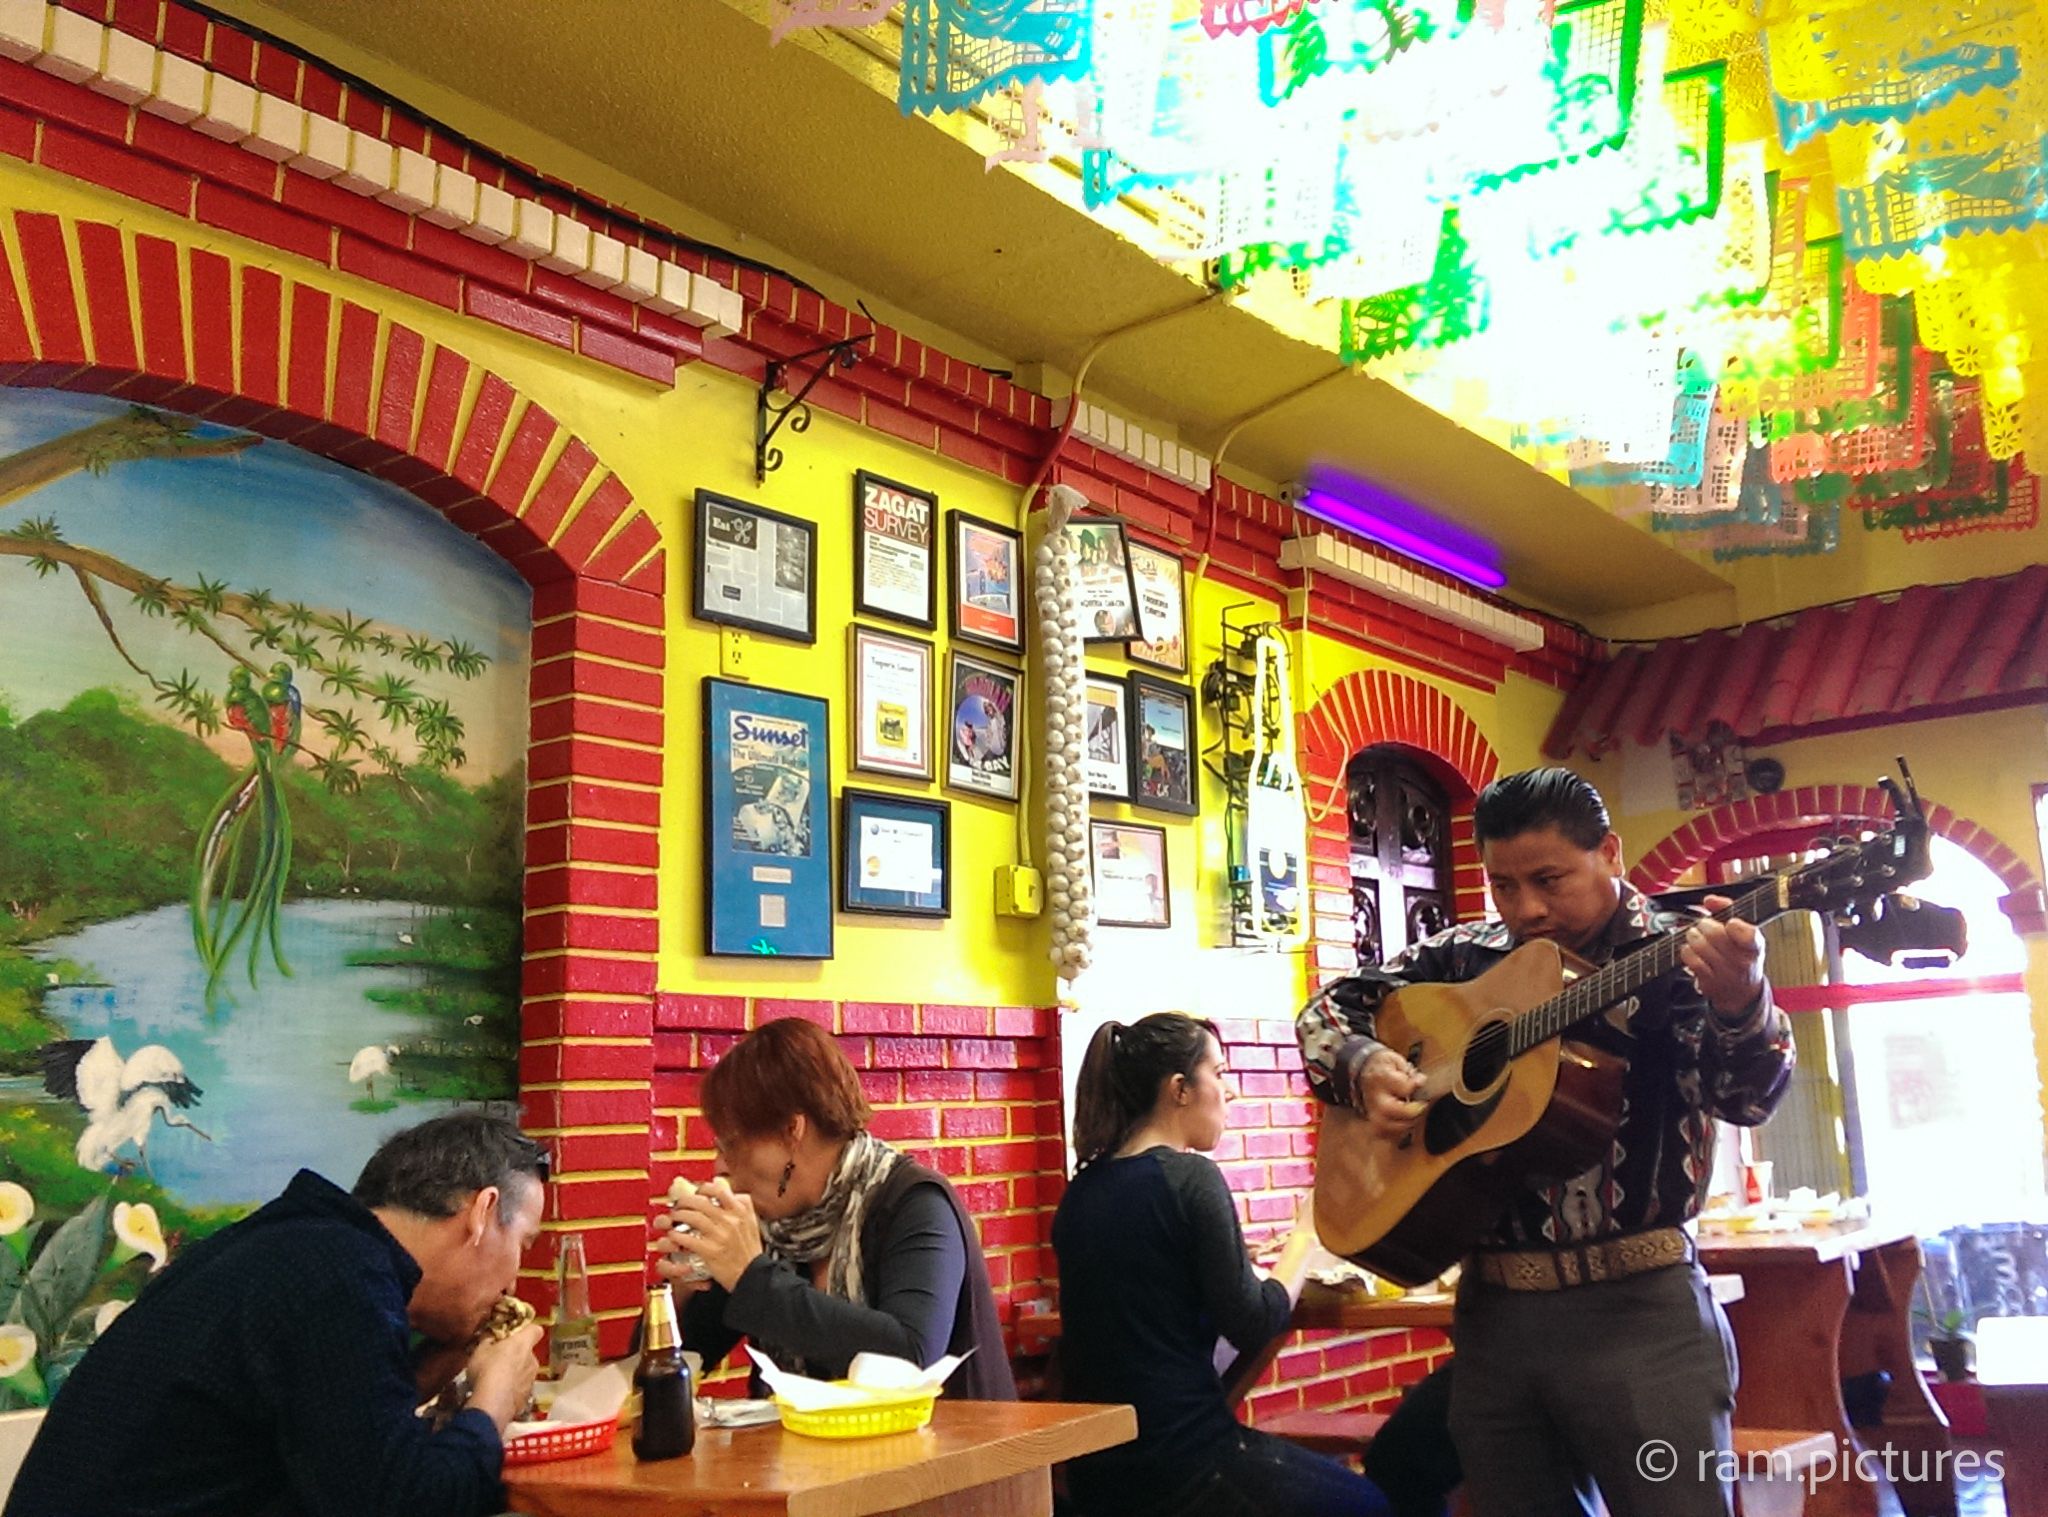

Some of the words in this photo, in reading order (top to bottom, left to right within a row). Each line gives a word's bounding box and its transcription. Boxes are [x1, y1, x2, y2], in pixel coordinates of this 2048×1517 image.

[865, 485, 929, 524] ZAGAT
[712, 517, 731, 533] Eat
[864, 507, 929, 543] SURVEY
[733, 715, 809, 748] Sunset
